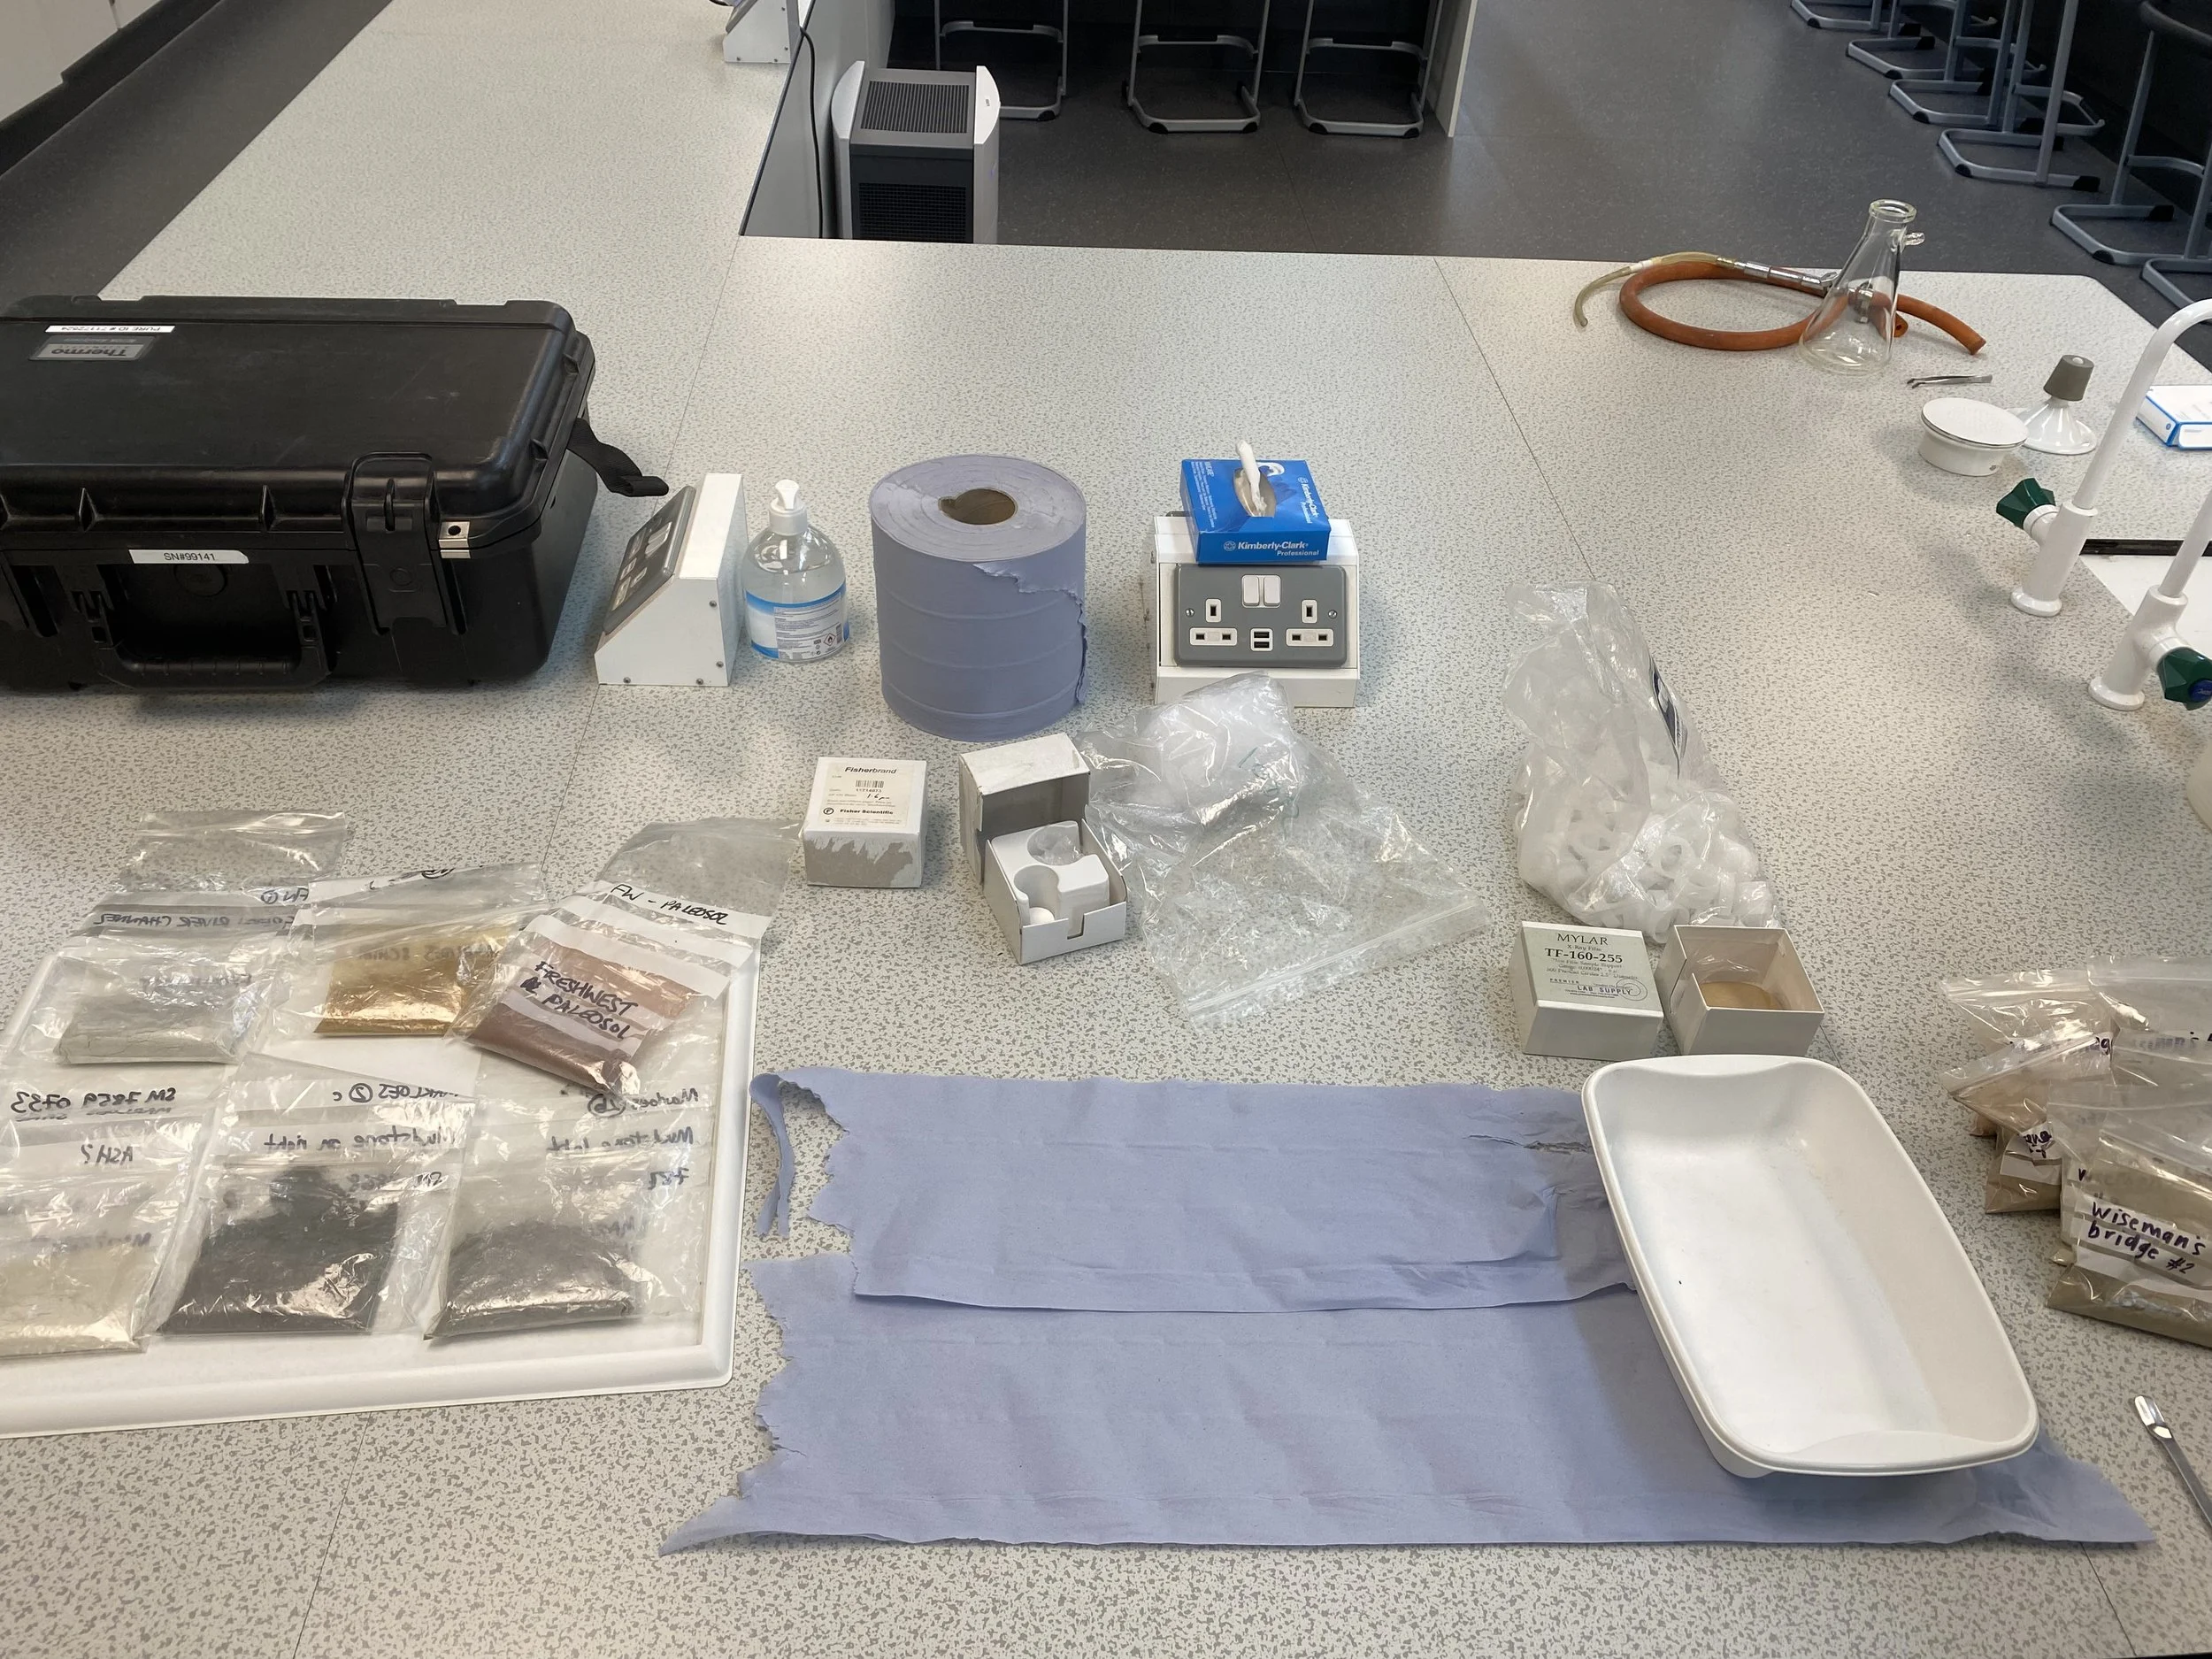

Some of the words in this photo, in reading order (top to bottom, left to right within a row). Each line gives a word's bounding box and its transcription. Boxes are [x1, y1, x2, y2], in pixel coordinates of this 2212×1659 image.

[51, 348, 127, 357] Thermo
[1237, 541, 1307, 550] Kimberly-Clark
[163, 552, 216, 561] SN#99141
[660, 900, 729, 926] PALEOSOL
[1557, 933, 1609, 945] MYLAR
[1545, 948, 1623, 964] TF-160-255
[534, 961, 639, 1017] FRESHWEST
[1599, 987, 1633, 995] SUPPLY
[541, 994, 633, 1040] PALEOSOL
[2092, 1201, 2207, 1256] Wiseman's
[2087, 1219, 2160, 1260] bridge
[2165, 1256, 2195, 1275] #2
